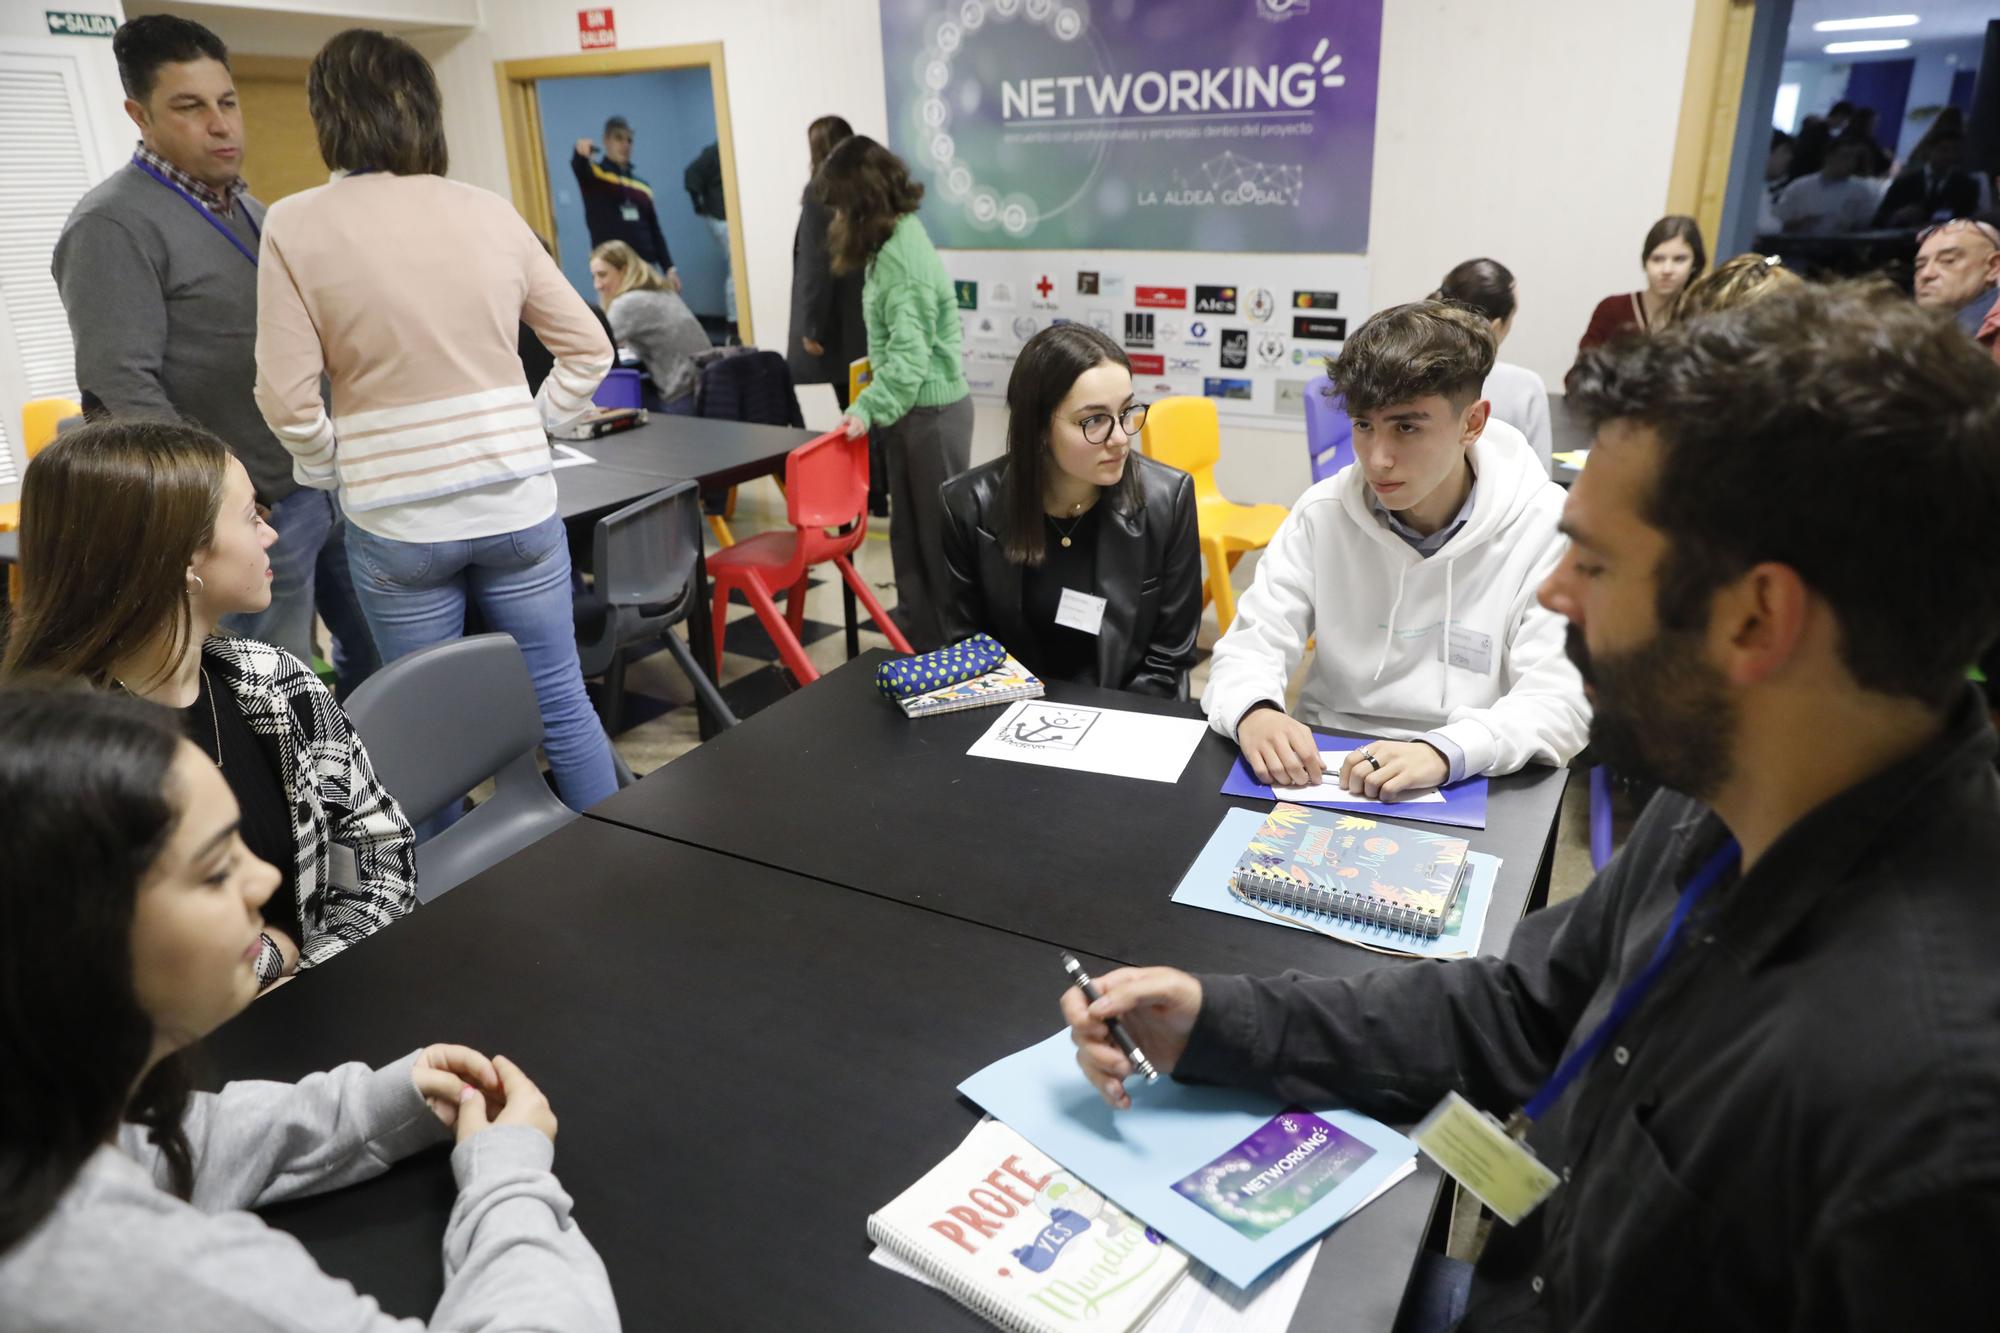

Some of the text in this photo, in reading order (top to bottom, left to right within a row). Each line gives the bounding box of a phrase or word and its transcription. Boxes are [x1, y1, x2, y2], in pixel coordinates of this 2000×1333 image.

[65, 13, 117, 34] SALIDA
[586, 9, 604, 27] SIN
[581, 29, 616, 47] SALIDA
[1001, 62, 1317, 119] NETWORKING
[1203, 125, 1239, 138] dentro
[1240, 123, 1260, 137] del
[1261, 122, 1313, 139] proyecto
[1137, 181, 1287, 206] LA ALDEA GLOBAL
[1197, 298, 1236, 312] Ales
[1241, 1131, 1328, 1197] NETWORKING
[928, 1154, 1053, 1255] PROFE
[1038, 1220, 1075, 1255] YES
